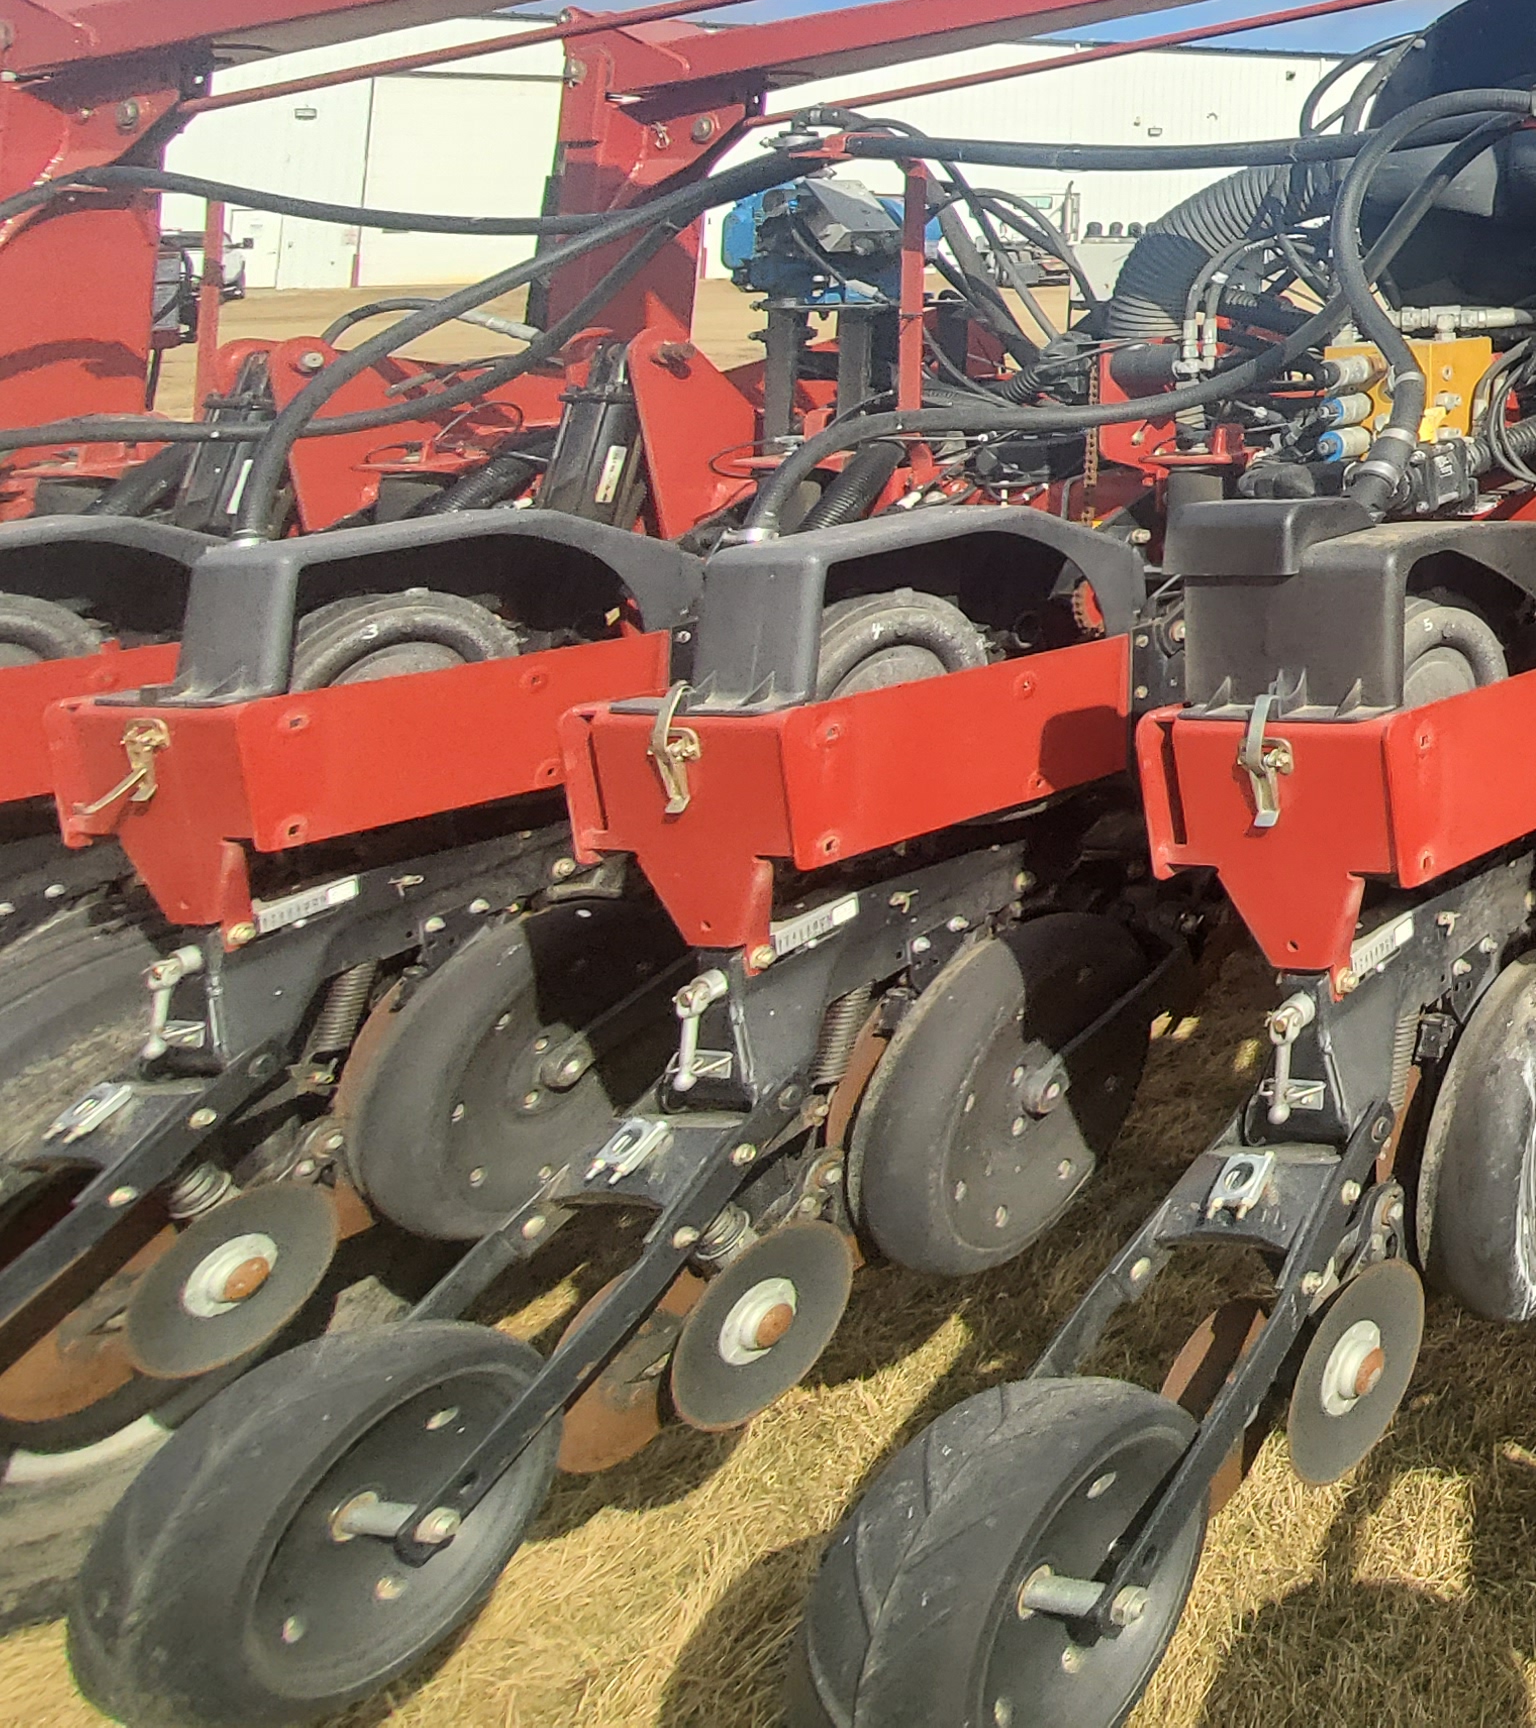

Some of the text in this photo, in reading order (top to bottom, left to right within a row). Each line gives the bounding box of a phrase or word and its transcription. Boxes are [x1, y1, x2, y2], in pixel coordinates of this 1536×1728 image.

[361, 623, 379, 640] 3
[871, 622, 885, 640] 4
[1423, 617, 1434, 632] 5
